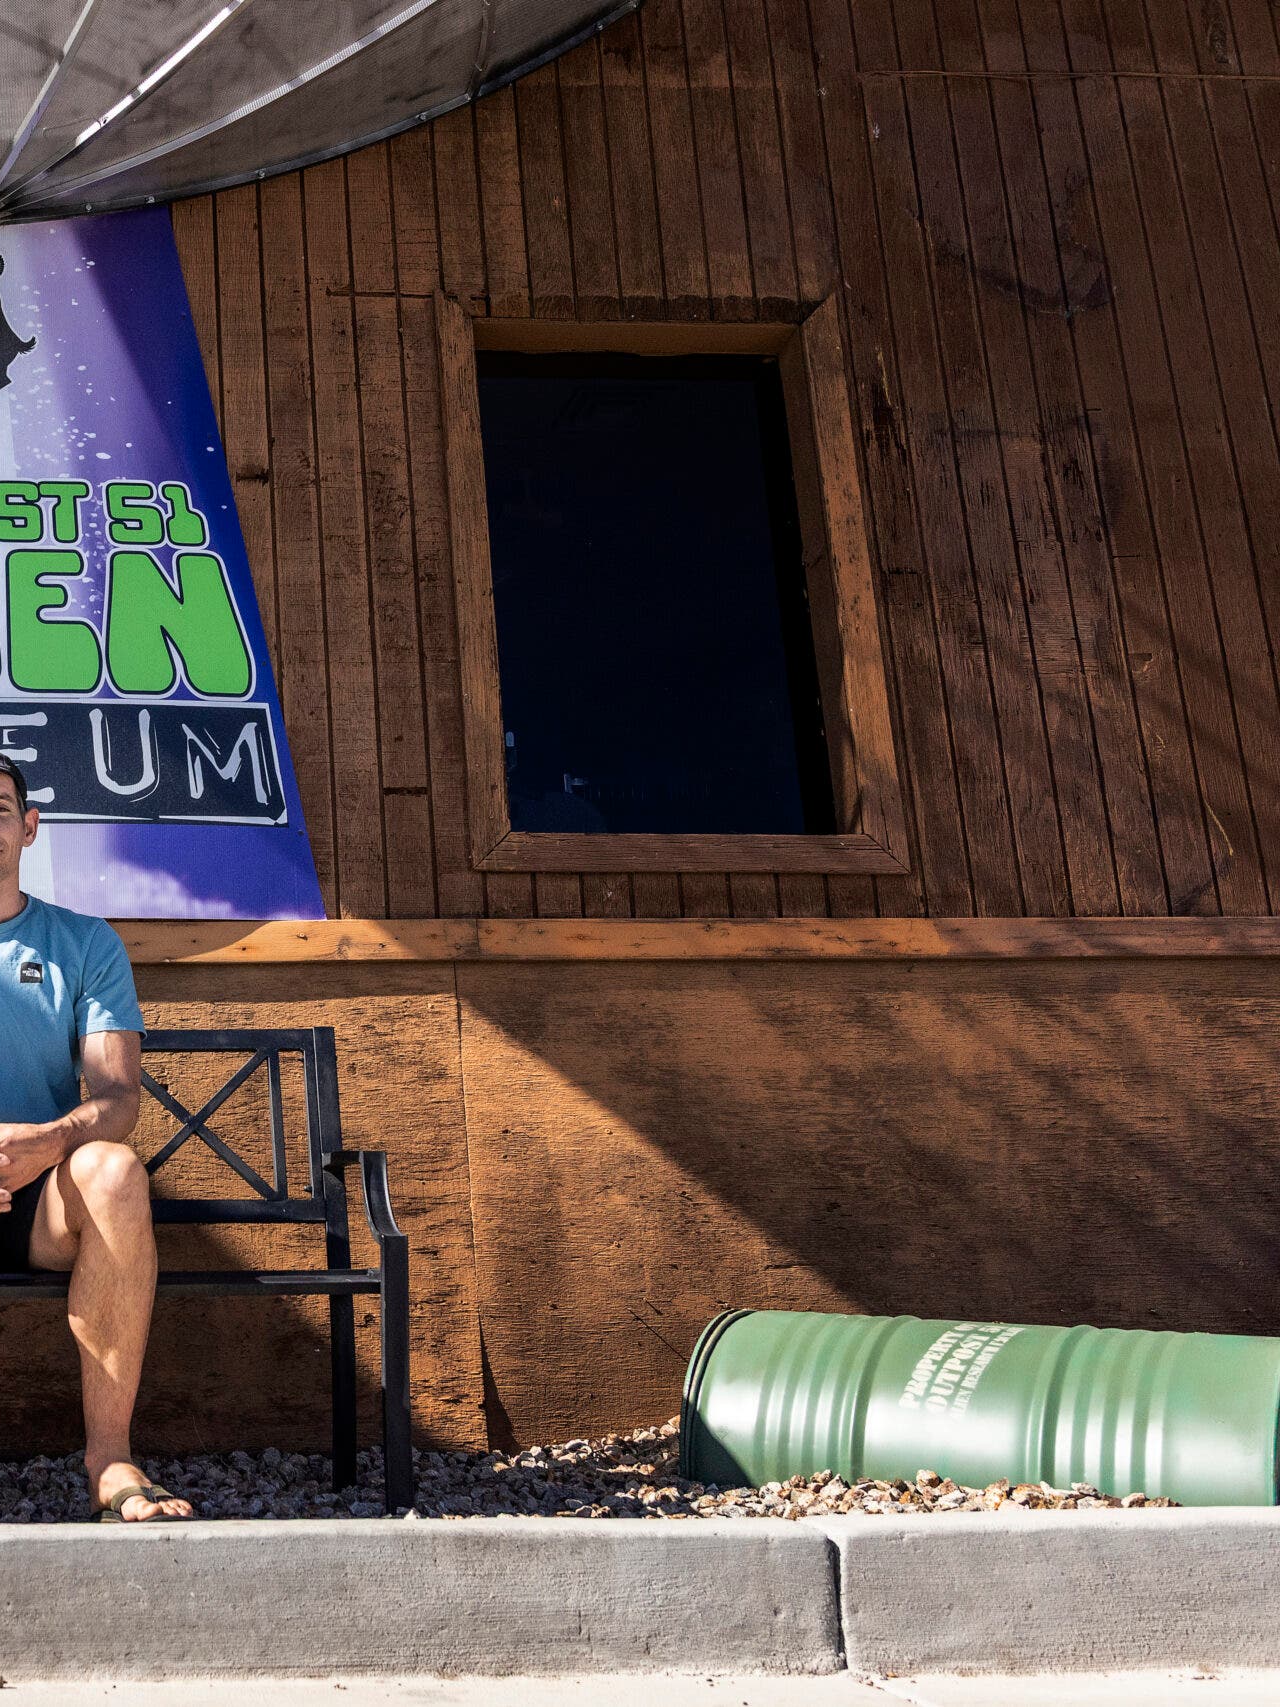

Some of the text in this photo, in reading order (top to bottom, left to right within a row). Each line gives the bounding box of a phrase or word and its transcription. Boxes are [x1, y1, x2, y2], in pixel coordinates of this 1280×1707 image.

[105, 480, 209, 548] 51
[899, 1331, 965, 1409] PROPERTY
[925, 1333, 991, 1413] OUTPOST
